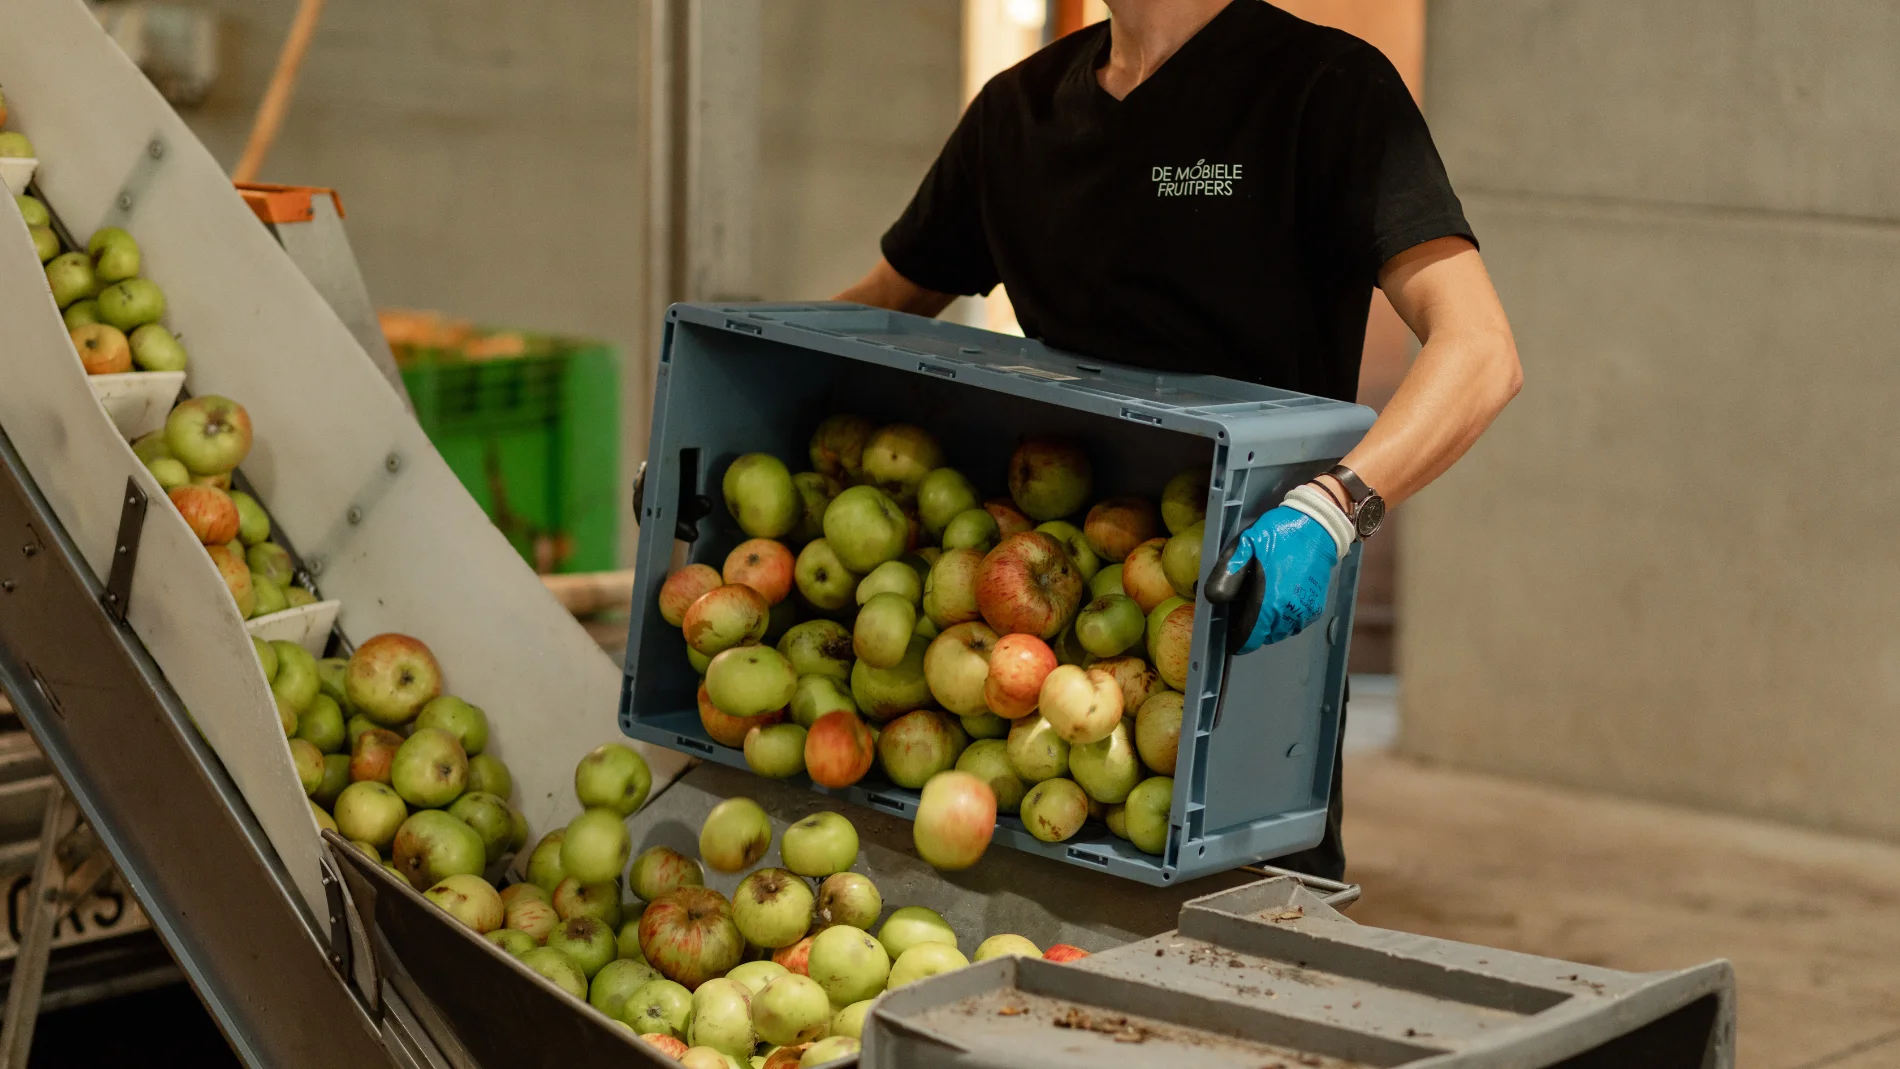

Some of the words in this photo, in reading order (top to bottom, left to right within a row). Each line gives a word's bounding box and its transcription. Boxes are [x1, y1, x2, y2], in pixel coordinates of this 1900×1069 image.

[1152, 166, 1173, 182] DE
[1175, 163, 1243, 181] MOBIELE
[1157, 180, 1233, 197] FRUITPERS
